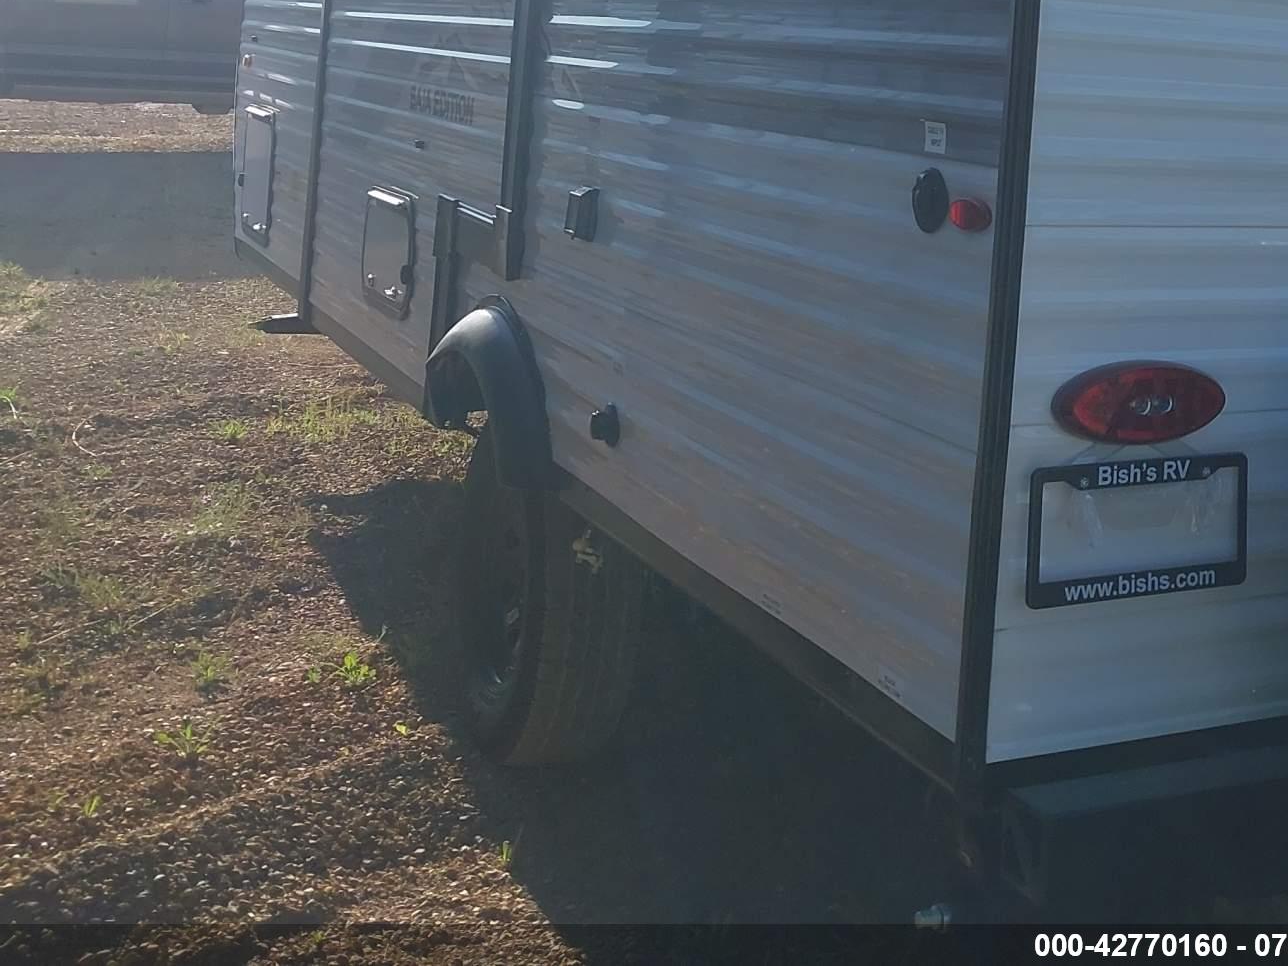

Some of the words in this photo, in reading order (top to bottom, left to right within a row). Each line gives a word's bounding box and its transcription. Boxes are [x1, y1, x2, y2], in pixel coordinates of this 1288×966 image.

[1098, 464, 1157, 485] Bish's
[1163, 459, 1190, 480] RV
[1064, 569, 1216, 602] www.bishs.com
